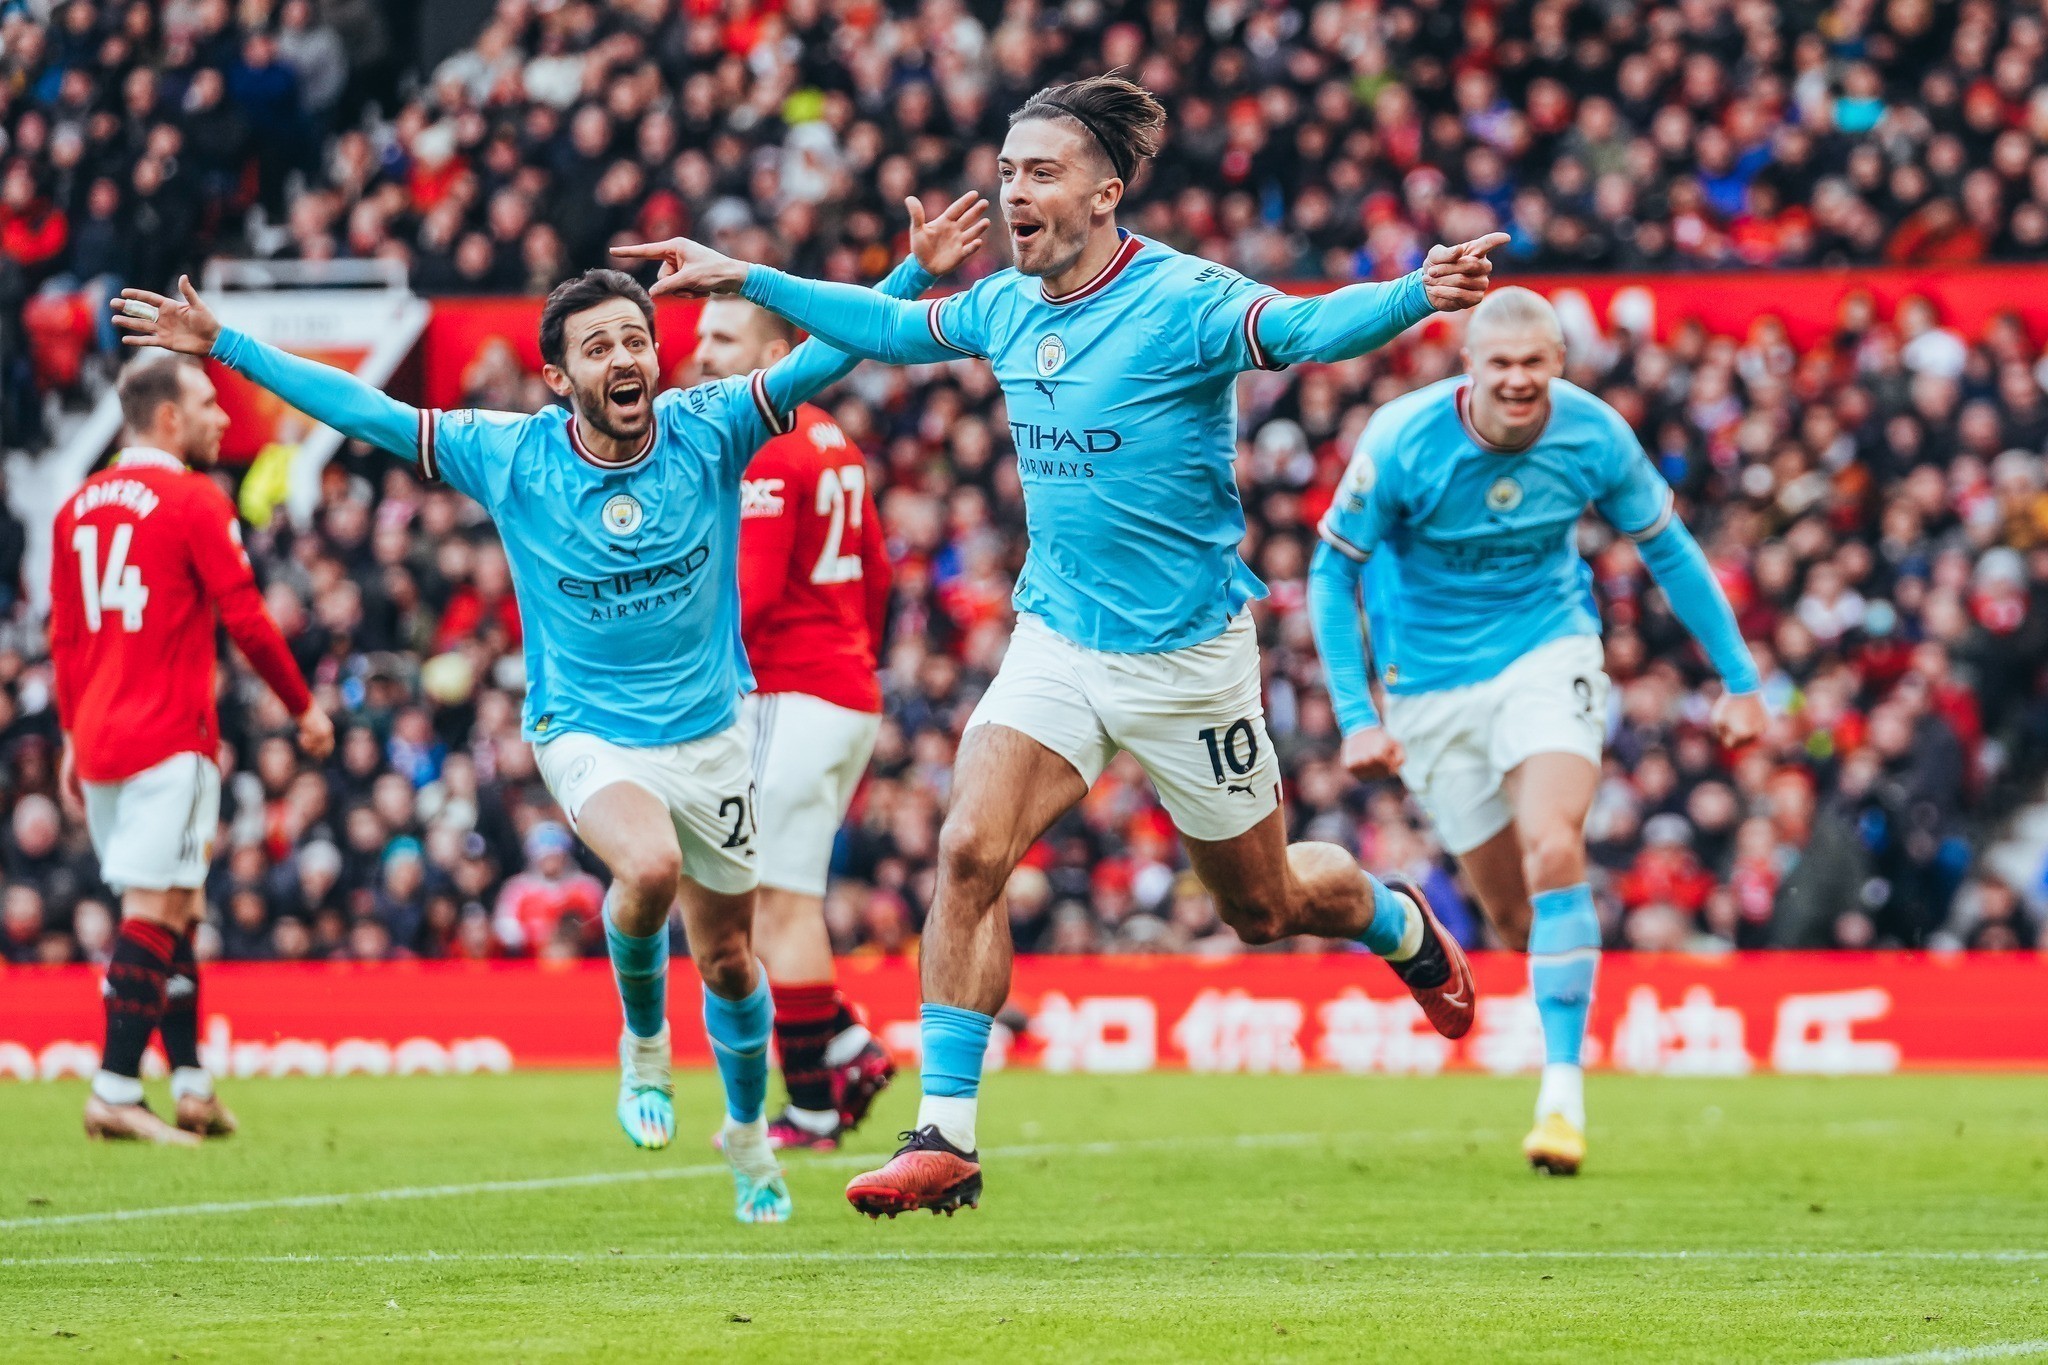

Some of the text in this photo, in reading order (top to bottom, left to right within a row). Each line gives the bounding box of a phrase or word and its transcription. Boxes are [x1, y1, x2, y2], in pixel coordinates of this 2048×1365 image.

[1009, 421, 1122, 454] TIHAD
[1019, 456, 1095, 479] AIRWAYS
[72, 522, 149, 634] 14
[558, 545, 710, 599] ETIHAD
[590, 582, 692, 621] AIRWAYS
[1198, 718, 1258, 786] 10
